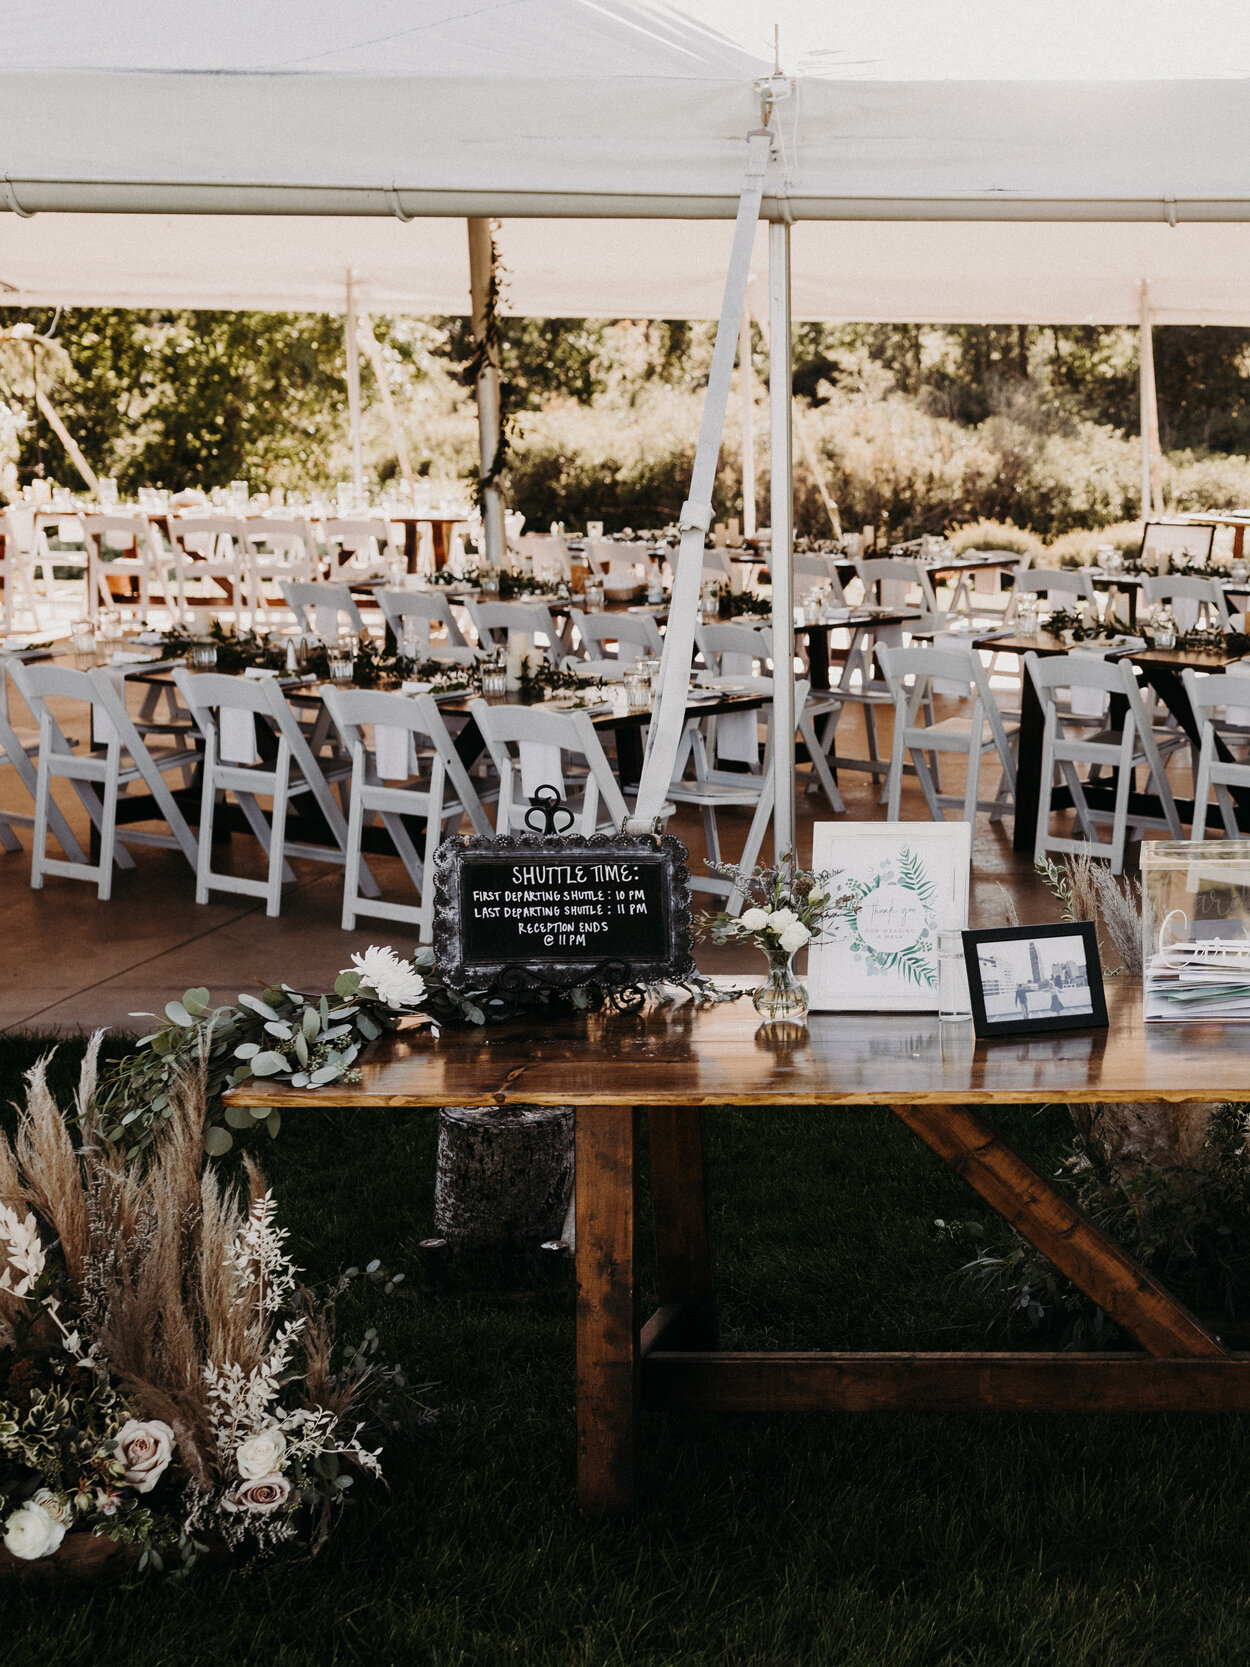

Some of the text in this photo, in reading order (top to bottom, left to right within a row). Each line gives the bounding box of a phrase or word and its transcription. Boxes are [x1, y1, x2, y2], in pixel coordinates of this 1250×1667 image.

[512, 864, 640, 885] SHUTTLE TIME:
[472, 890, 503, 902] FIRST
[504, 890, 561, 903] DEPARTING
[562, 890, 605, 902] SHUTTLE
[615, 890, 626, 901] 10
[628, 889, 646, 901] PM
[474, 906, 501, 919] LAST
[503, 906, 560, 919] DEPARTING
[563, 904, 604, 916] SHUTTLE
[617, 903, 626, 915] 11
[629, 903, 648, 915] PM
[518, 921, 609, 935] RECEPTION ENDS
[543, 933, 587, 947] @ 11 PM
